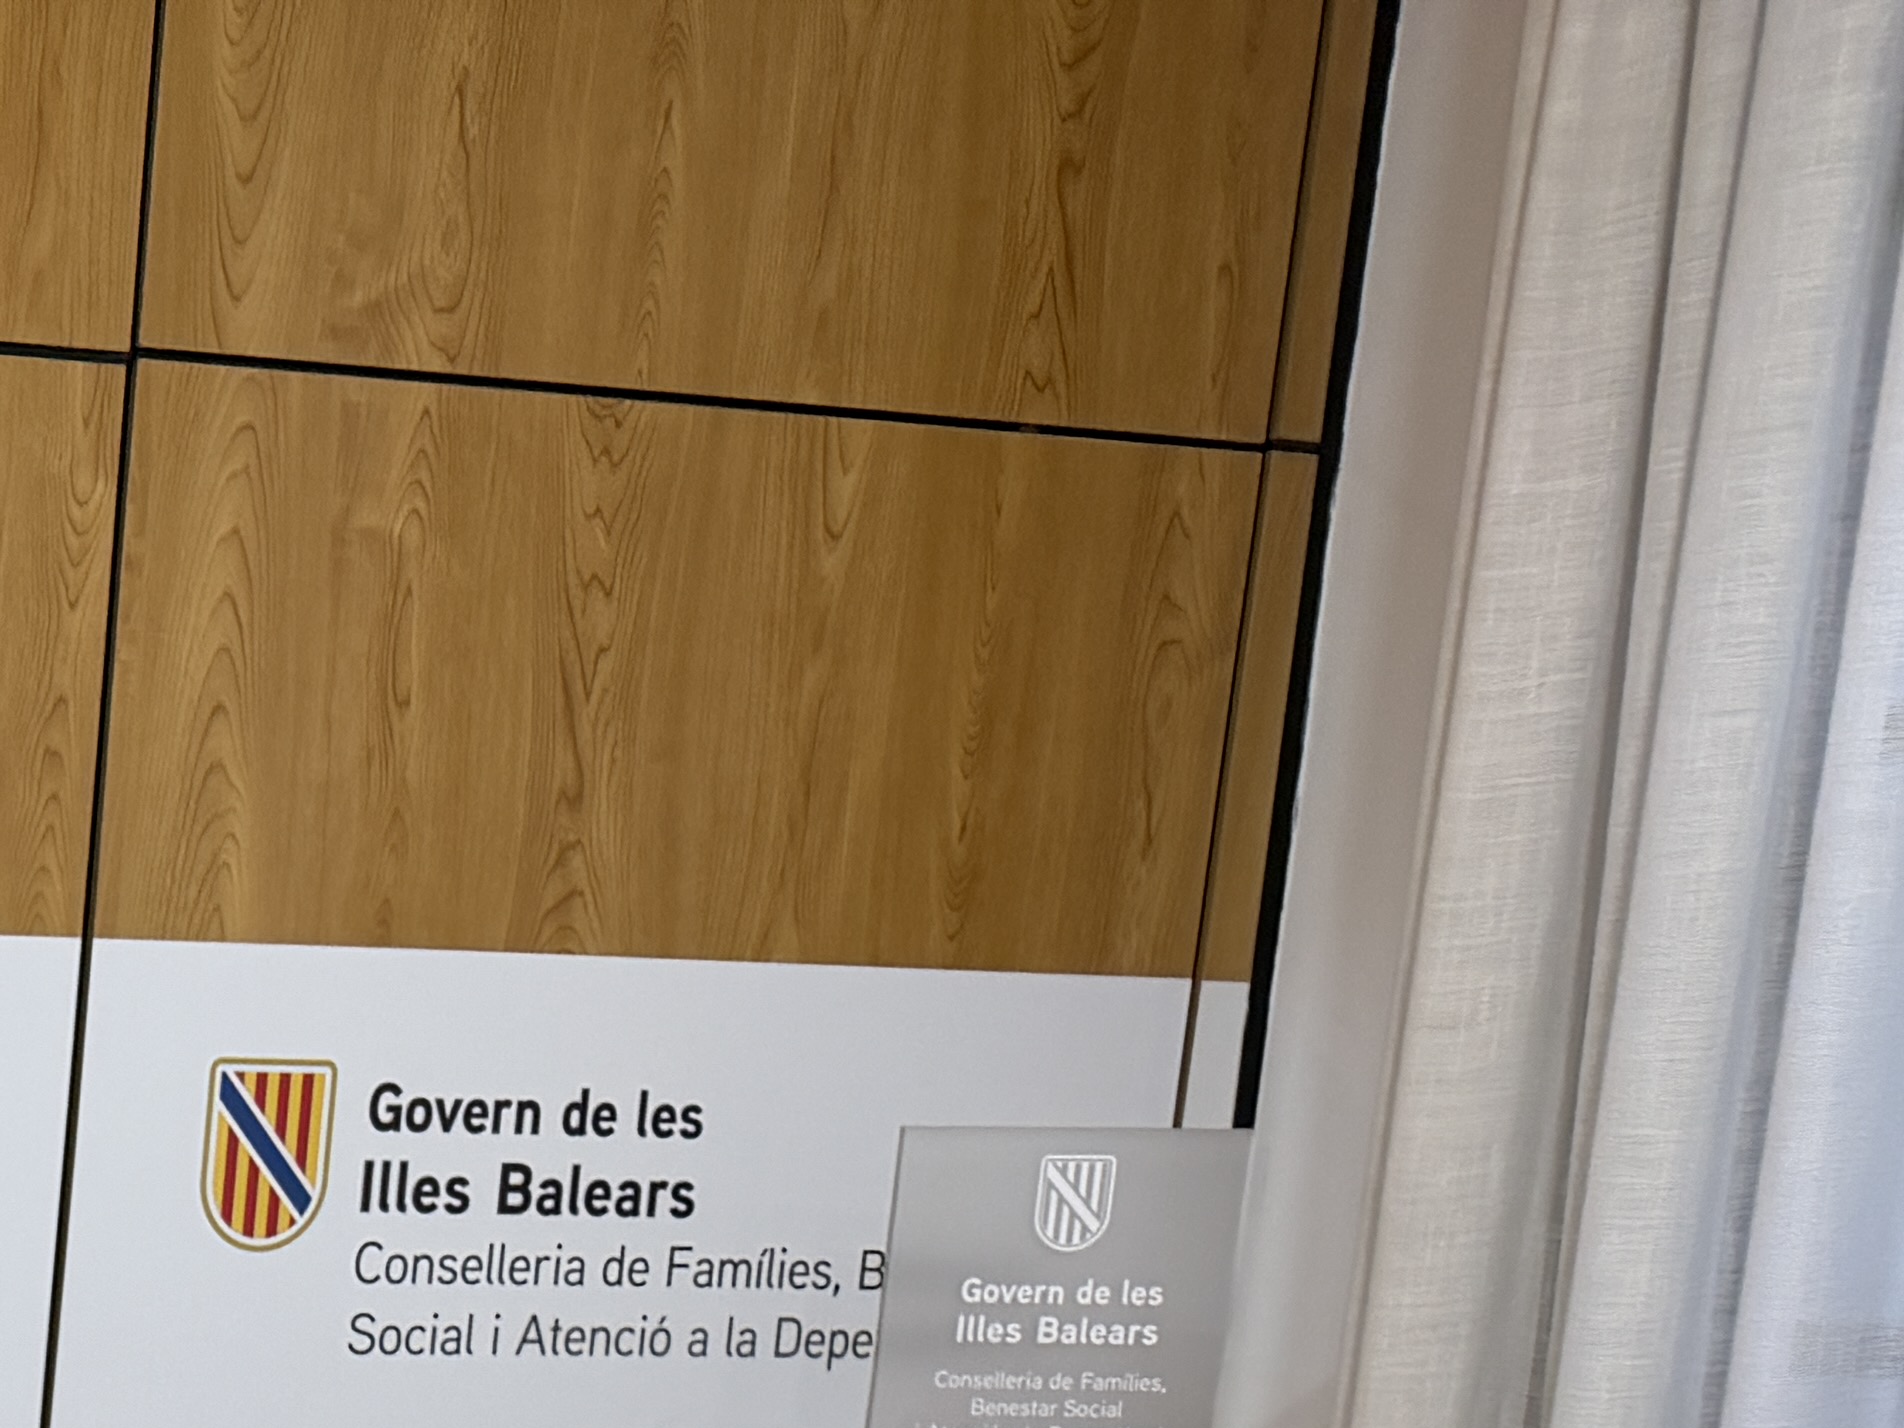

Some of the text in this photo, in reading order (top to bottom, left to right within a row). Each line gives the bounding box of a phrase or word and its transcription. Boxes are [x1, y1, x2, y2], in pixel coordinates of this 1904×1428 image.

[369, 1082, 703, 1140] Govern de les
[360, 1160, 695, 1219] Illes Balears
[355, 1241, 585, 1286] Conselleria
[602, 1245, 649, 1287] de
[666, 1246, 840, 1297] Famílies,
[961, 1278, 1163, 1306] Govern de les
[348, 1313, 474, 1356] Social
[492, 1313, 501, 1356] i
[515, 1314, 671, 1357] Atenció
[688, 1328, 708, 1357] a
[726, 1316, 757, 1358] la
[956, 1313, 1158, 1346] Illes Balears
[934, 1371, 1043, 1390] Conselleria
[1049, 1373, 1074, 1391] de
[971, 1399, 1123, 1418] Benestar Social
